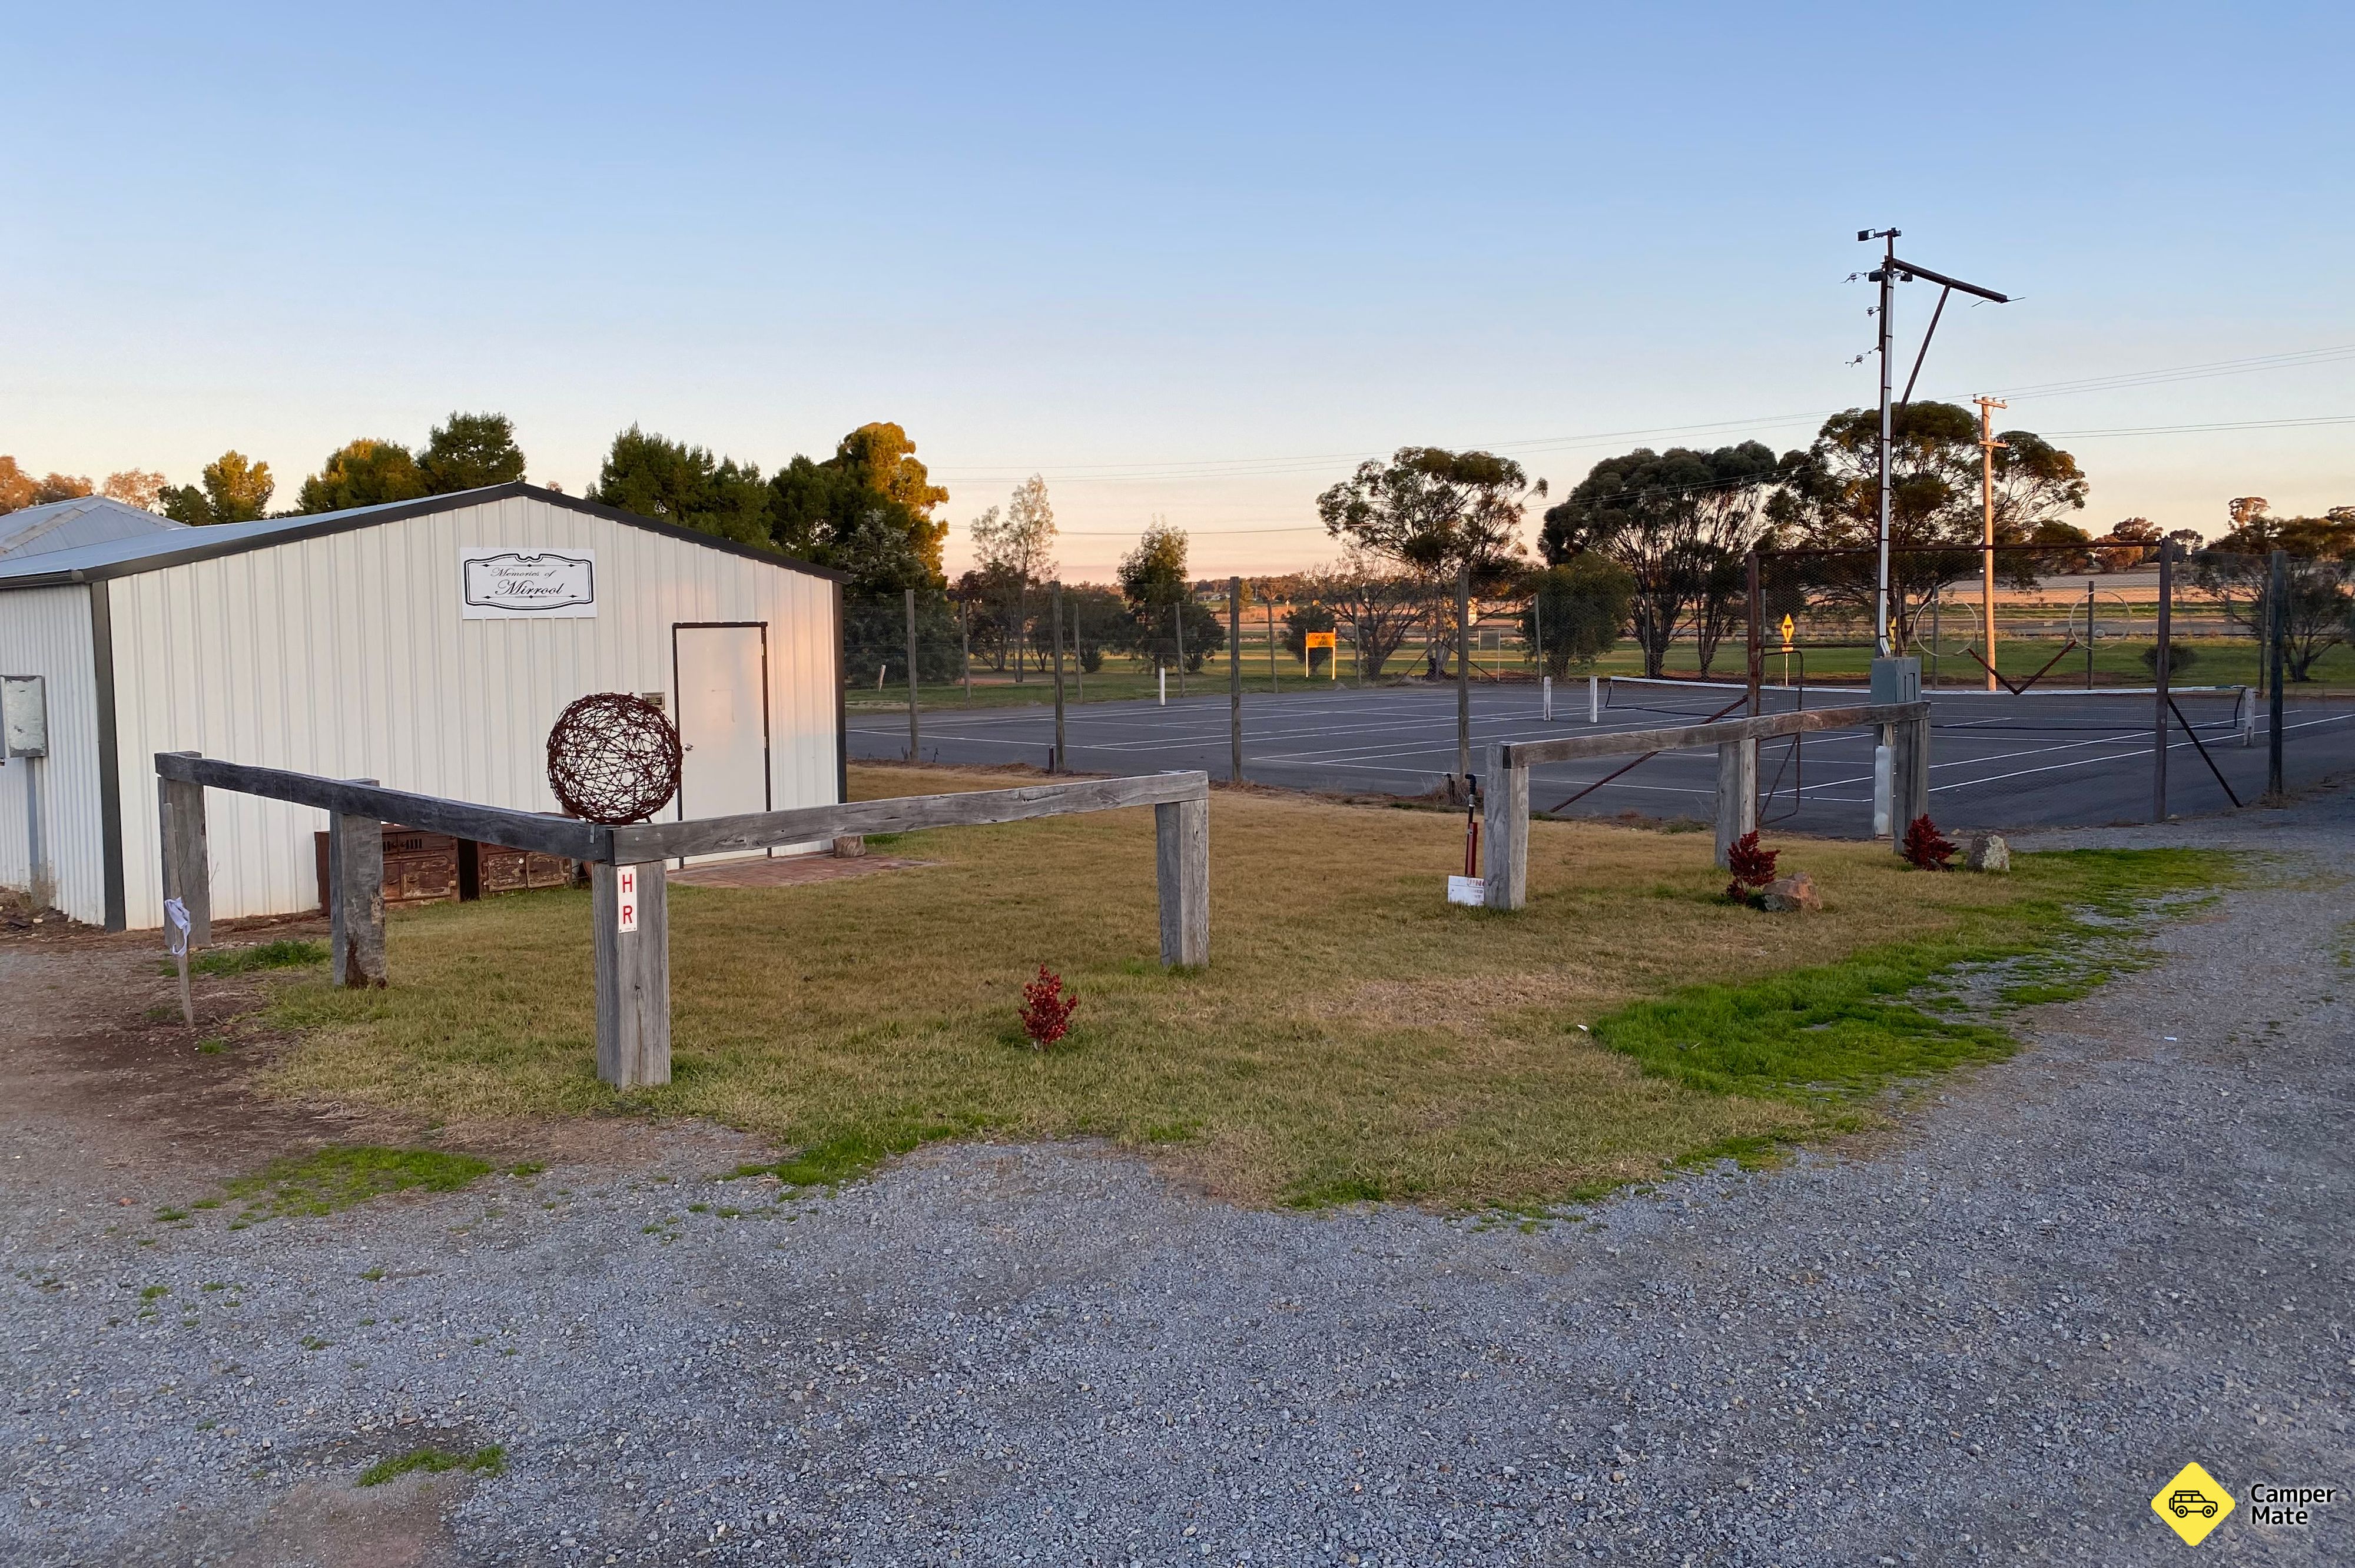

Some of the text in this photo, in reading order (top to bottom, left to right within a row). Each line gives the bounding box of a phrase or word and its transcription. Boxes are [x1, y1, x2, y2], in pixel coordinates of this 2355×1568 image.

[490, 567, 557, 579] Memories of
[495, 579, 565, 595] Mirrool
